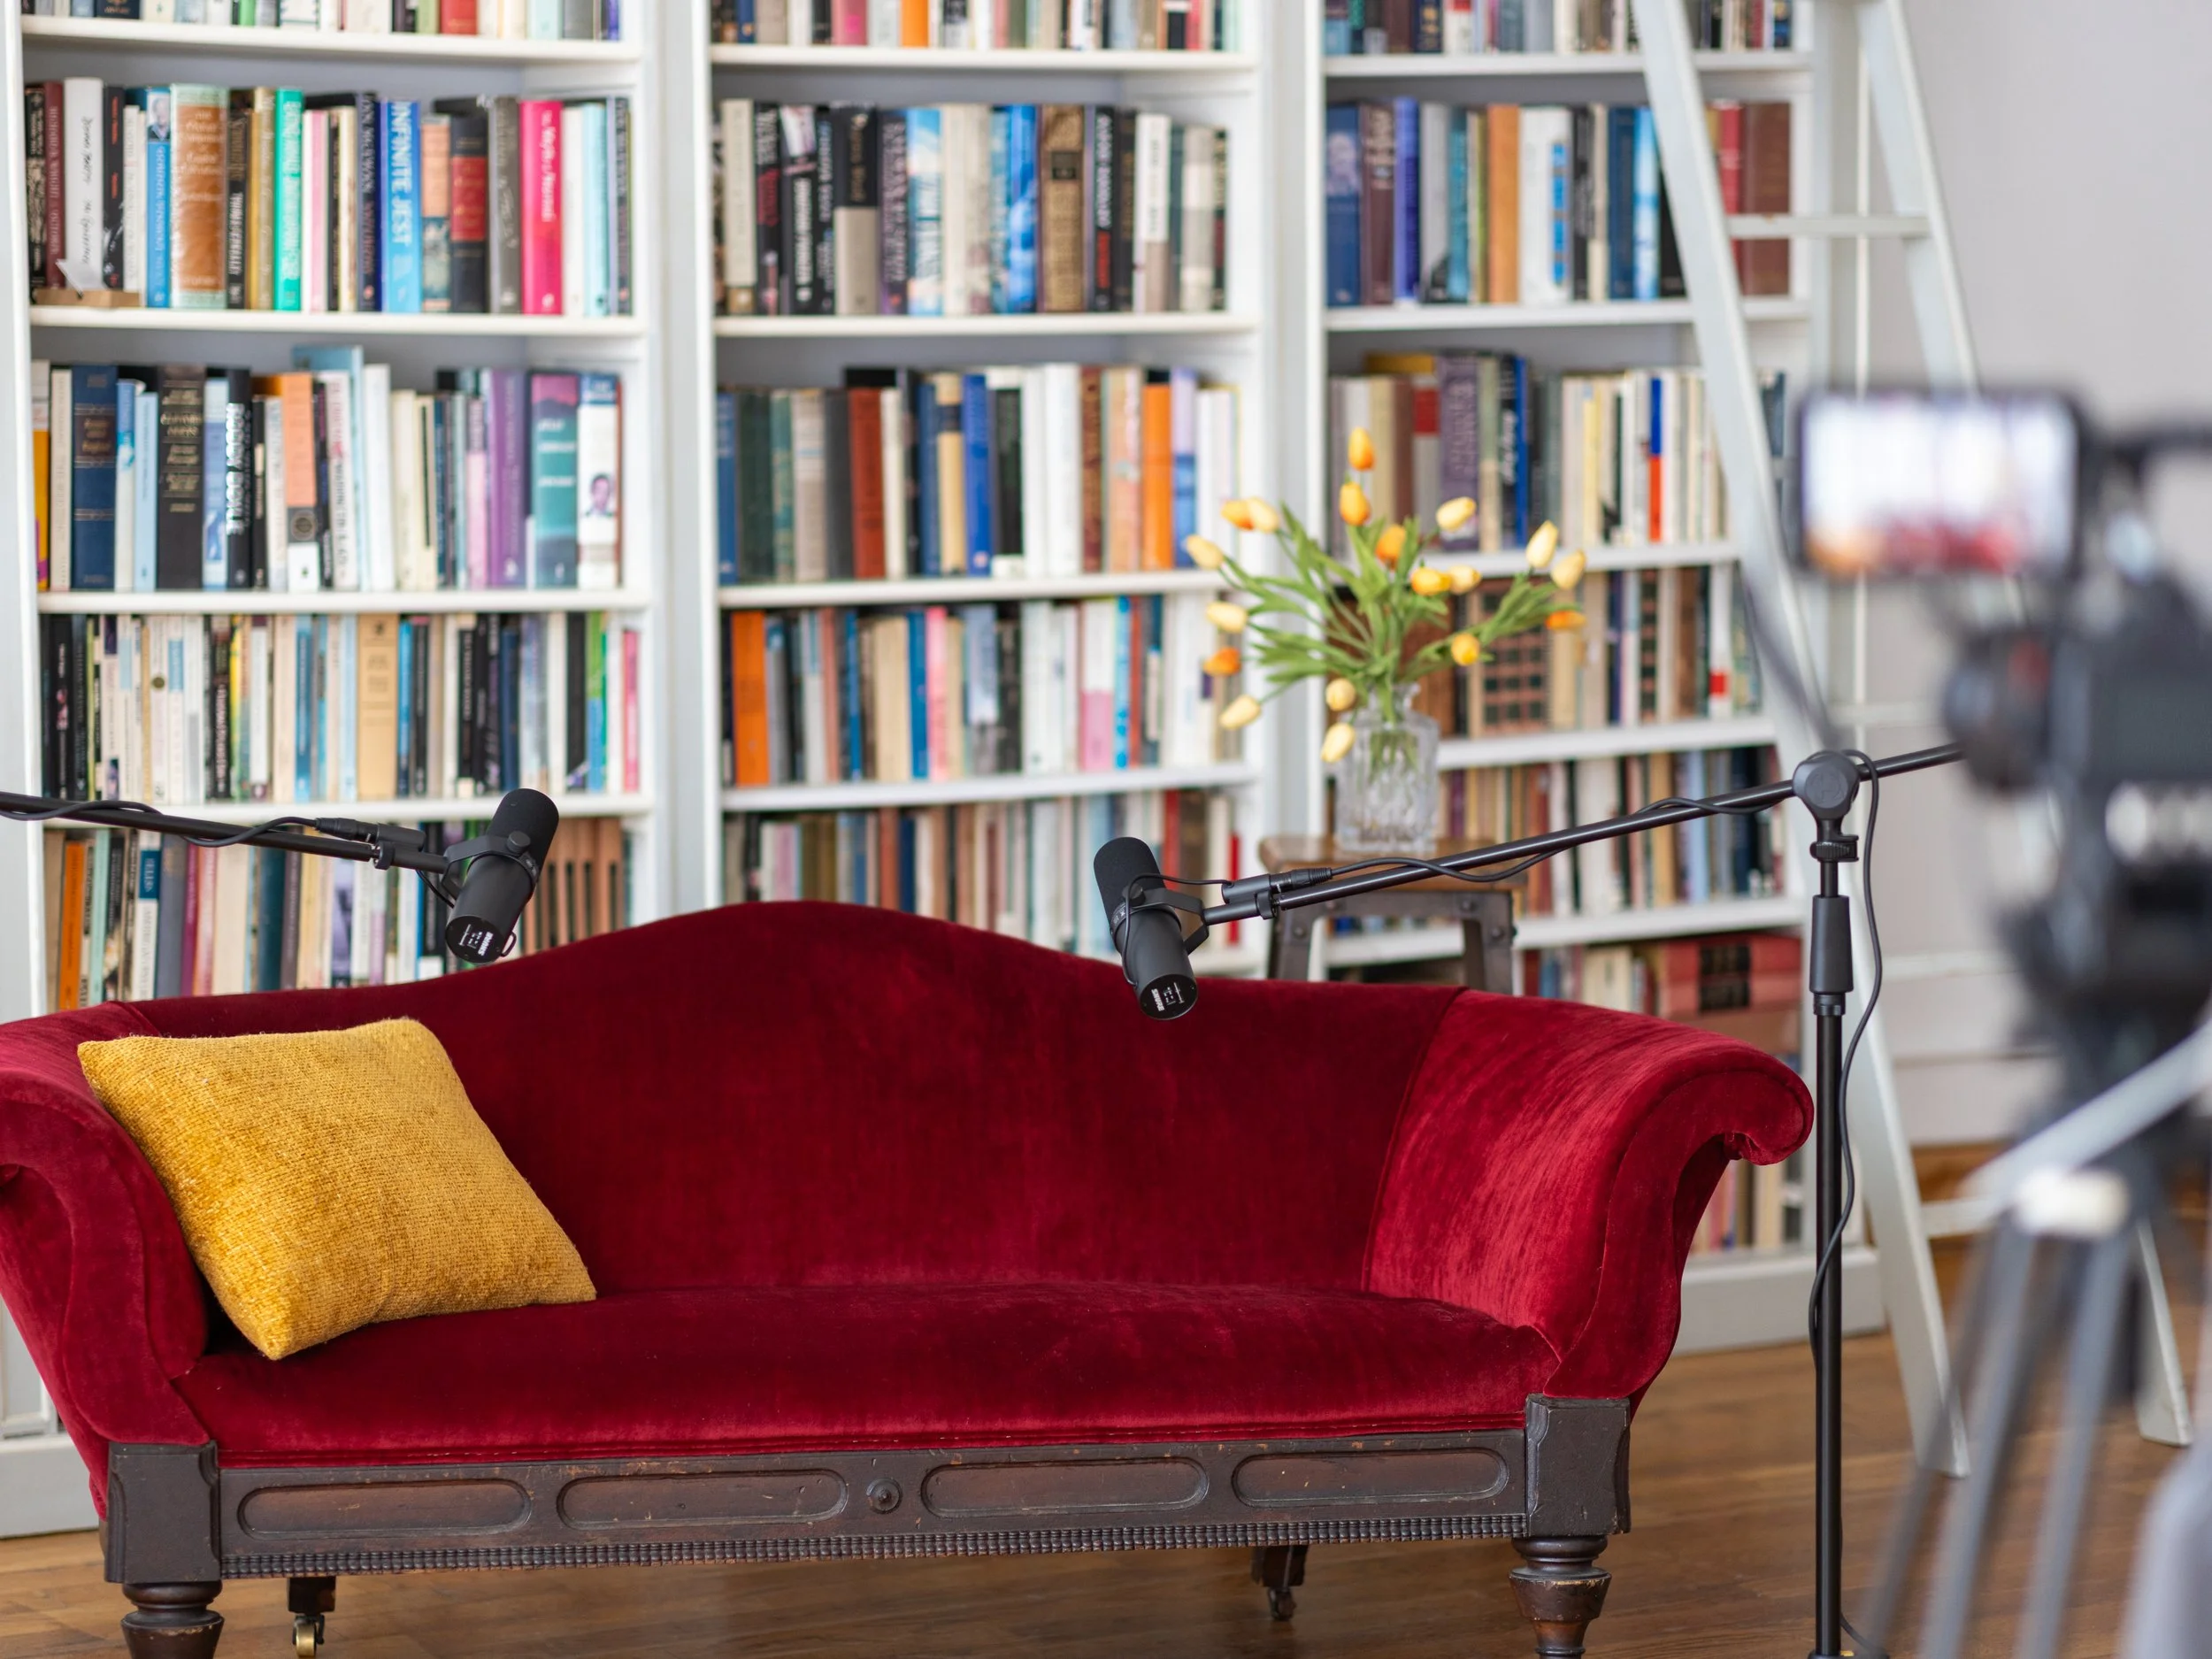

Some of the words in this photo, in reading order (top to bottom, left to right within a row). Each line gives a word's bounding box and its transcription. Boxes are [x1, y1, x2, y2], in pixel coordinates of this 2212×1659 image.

[391, 101, 413, 193] INFINITE
[391, 196, 413, 247] JEST
[225, 403, 246, 467] RODDY
[225, 470, 246, 535] DOYLE
[478, 931, 494, 956] SHURE
[1151, 987, 1165, 1012] SHURE
